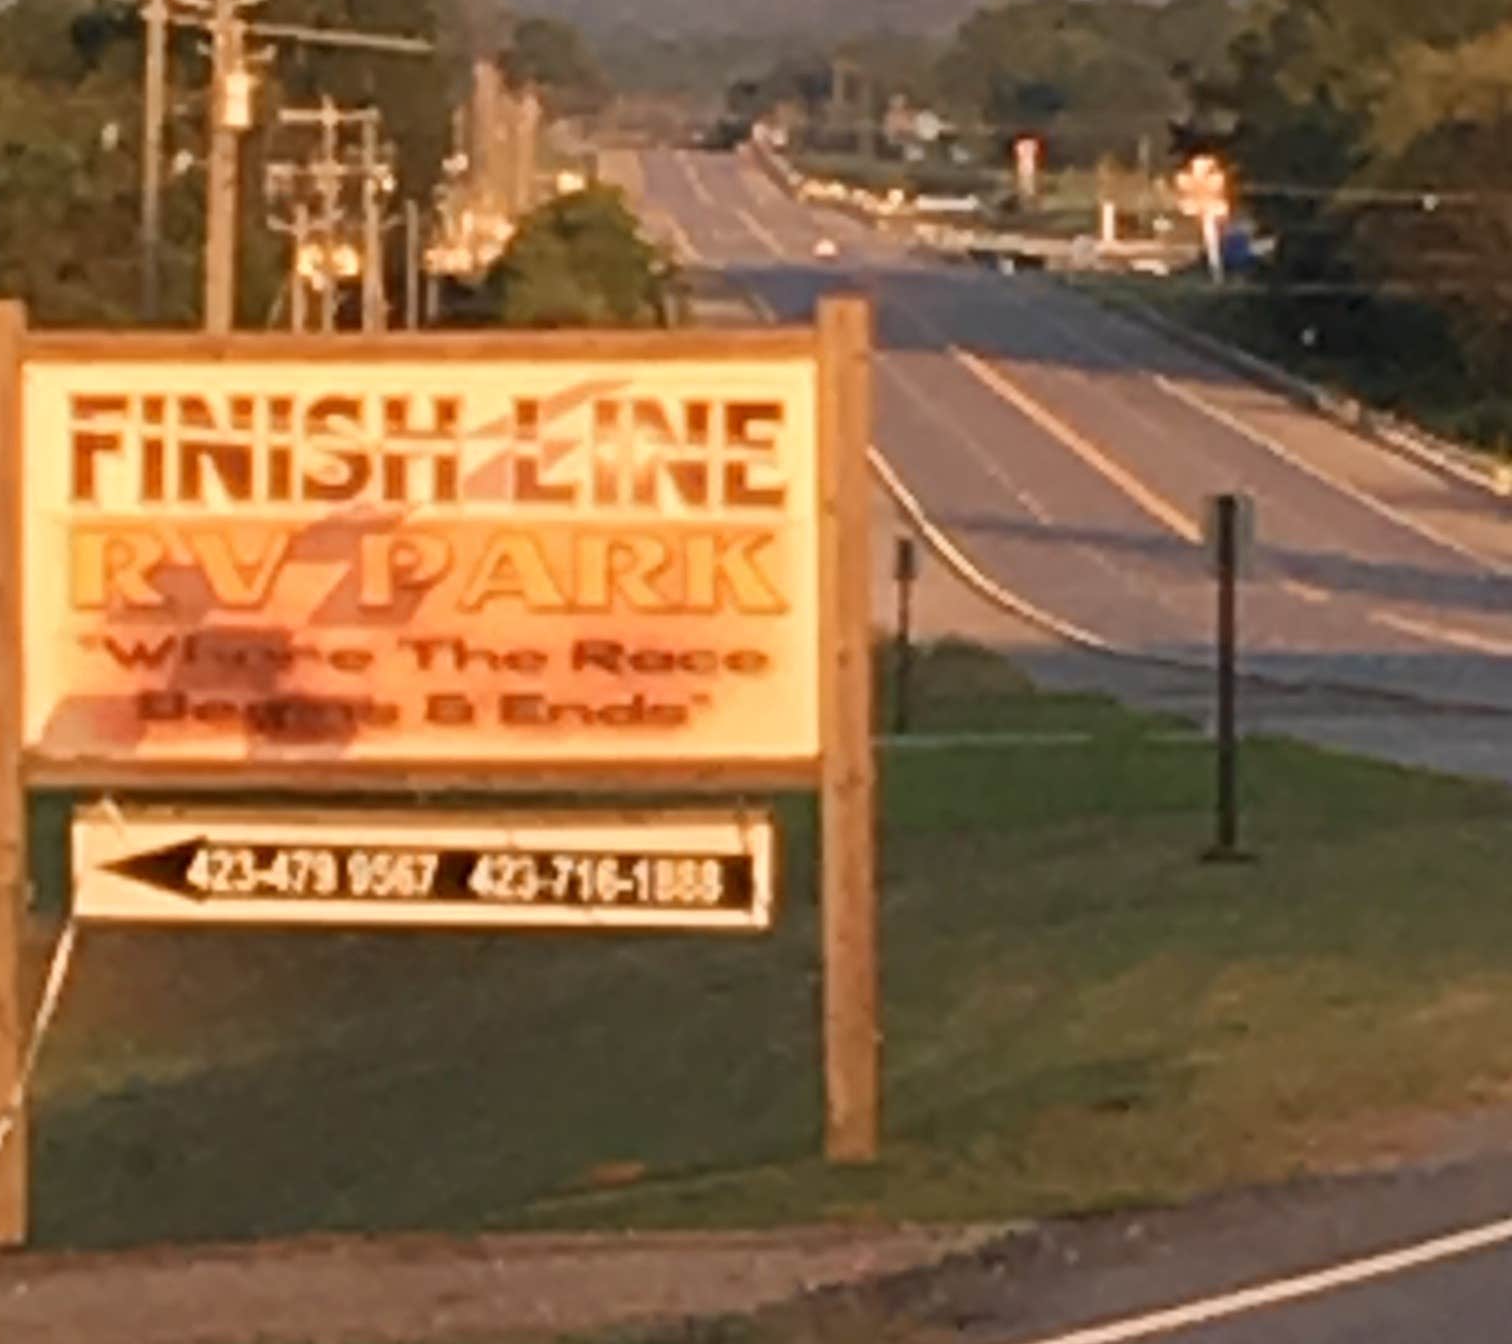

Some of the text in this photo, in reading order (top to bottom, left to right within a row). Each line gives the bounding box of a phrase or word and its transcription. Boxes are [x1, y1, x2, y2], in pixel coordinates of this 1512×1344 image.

[70, 394, 787, 508] FINISH LINE
[70, 520, 794, 616] RV PARK
[397, 635, 548, 673] The
[571, 637, 770, 677] Race
